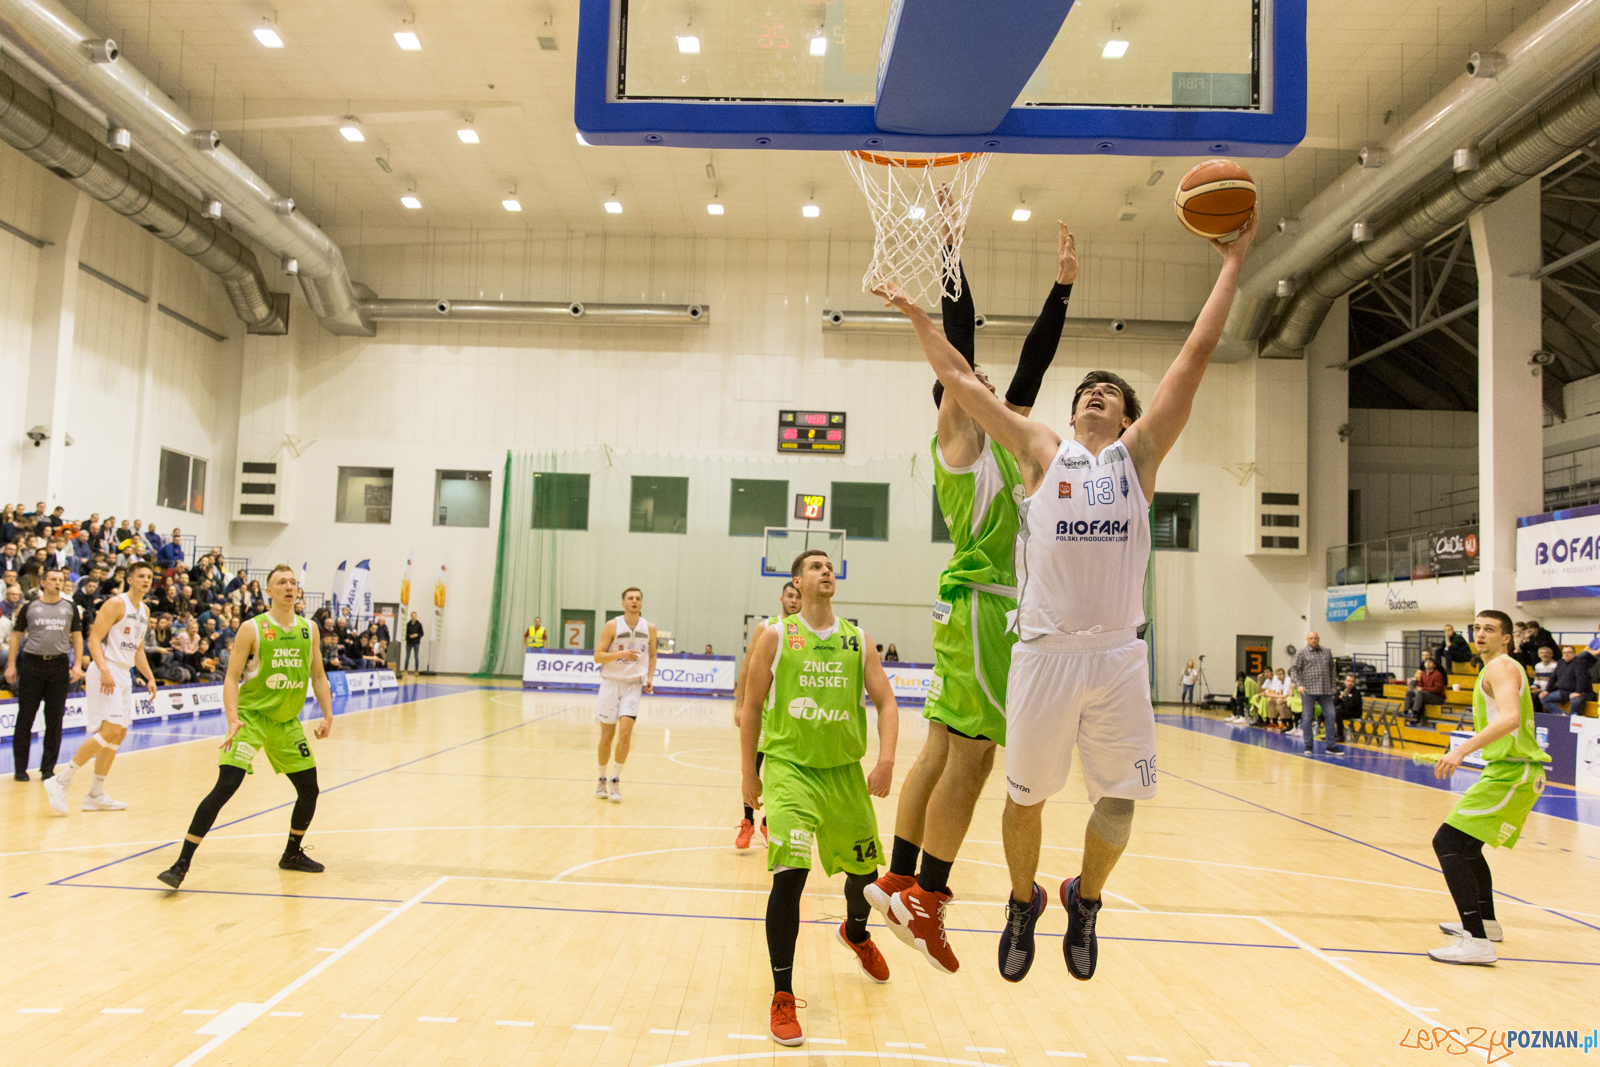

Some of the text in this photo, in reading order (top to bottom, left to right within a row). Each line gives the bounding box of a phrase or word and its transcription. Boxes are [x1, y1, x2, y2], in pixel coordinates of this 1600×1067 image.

[831, 415, 839, 423] 2
[1083, 476, 1115, 506] 13
[805, 505, 819, 518] 10
[1388, 598, 1419, 610] Budchem
[35, 618, 66, 627] VERONI
[301, 628, 309, 639] 6
[569, 628, 580, 645] 2
[841, 635, 859, 652] 14
[273, 648, 300, 657] ZNICZ
[271, 659, 303, 668] BASKET
[803, 661, 843, 673] ZNICZ
[1250, 654, 1262, 673] 3
[799, 675, 848, 688] BASKET
[199, 693, 220, 703] NICKEL
[802, 707, 850, 721] UNIA
[298, 742, 311, 758] 6
[853, 840, 877, 863] 14
